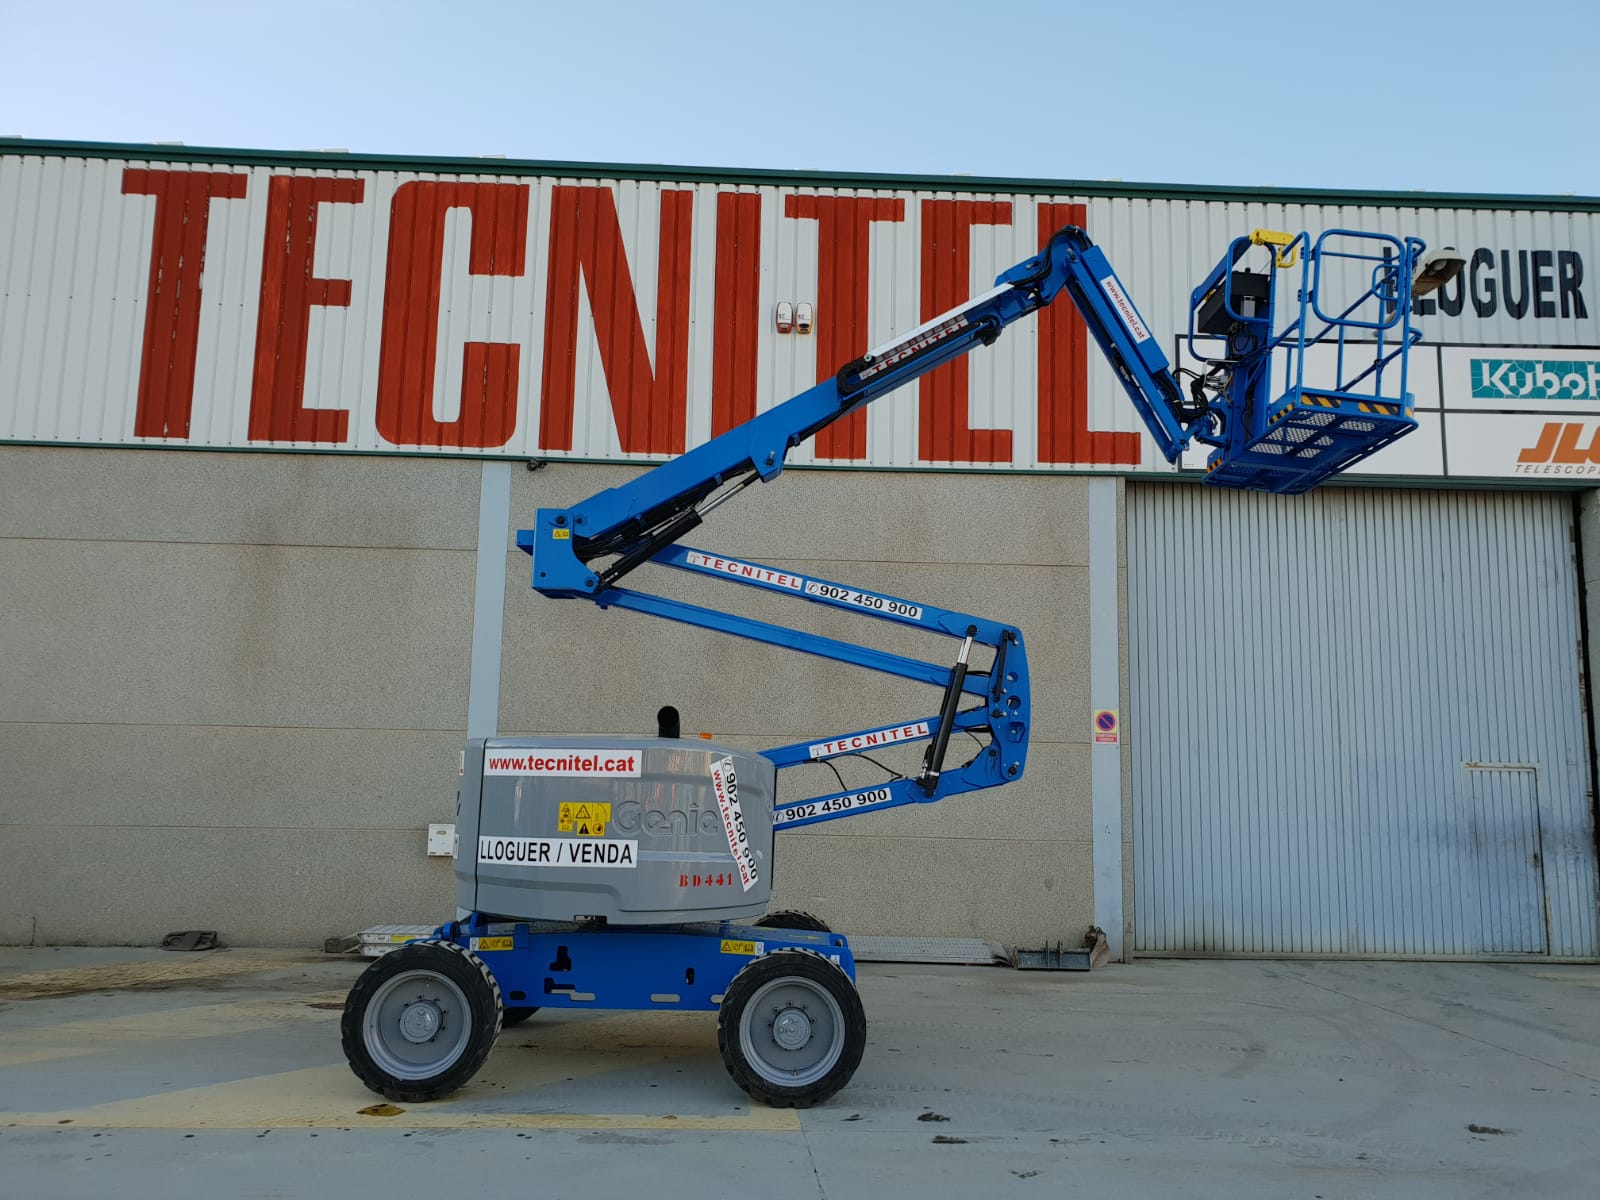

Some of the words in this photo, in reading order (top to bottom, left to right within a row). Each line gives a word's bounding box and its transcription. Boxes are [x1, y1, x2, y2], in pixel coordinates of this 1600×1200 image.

[122, 168, 1141, 464] TECNITEL
[1106, 281, 1145, 339] www.tecnitel.cat
[1517, 422, 1600, 464] JL
[1515, 464, 1600, 475] TELESCOP
[701, 555, 799, 589] TECNITEL
[819, 585, 849, 601] 902
[853, 593, 883, 610] 450
[888, 600, 918, 618] 900
[824, 724, 927, 753] TECNITEL
[489, 754, 635, 773] www.tecnitel.cat
[612, 800, 720, 838] Genie
[786, 804, 816, 821] 902
[822, 797, 851, 813] 450
[858, 789, 887, 806] 900
[713, 769, 750, 885] www.tecnitel.cat
[726, 773, 738, 806] 902
[734, 811, 746, 843] 450
[742, 847, 758, 880] 900
[480, 839, 550, 862] LLOGUER
[557, 842, 563, 864] /
[569, 842, 633, 864] VENDA
